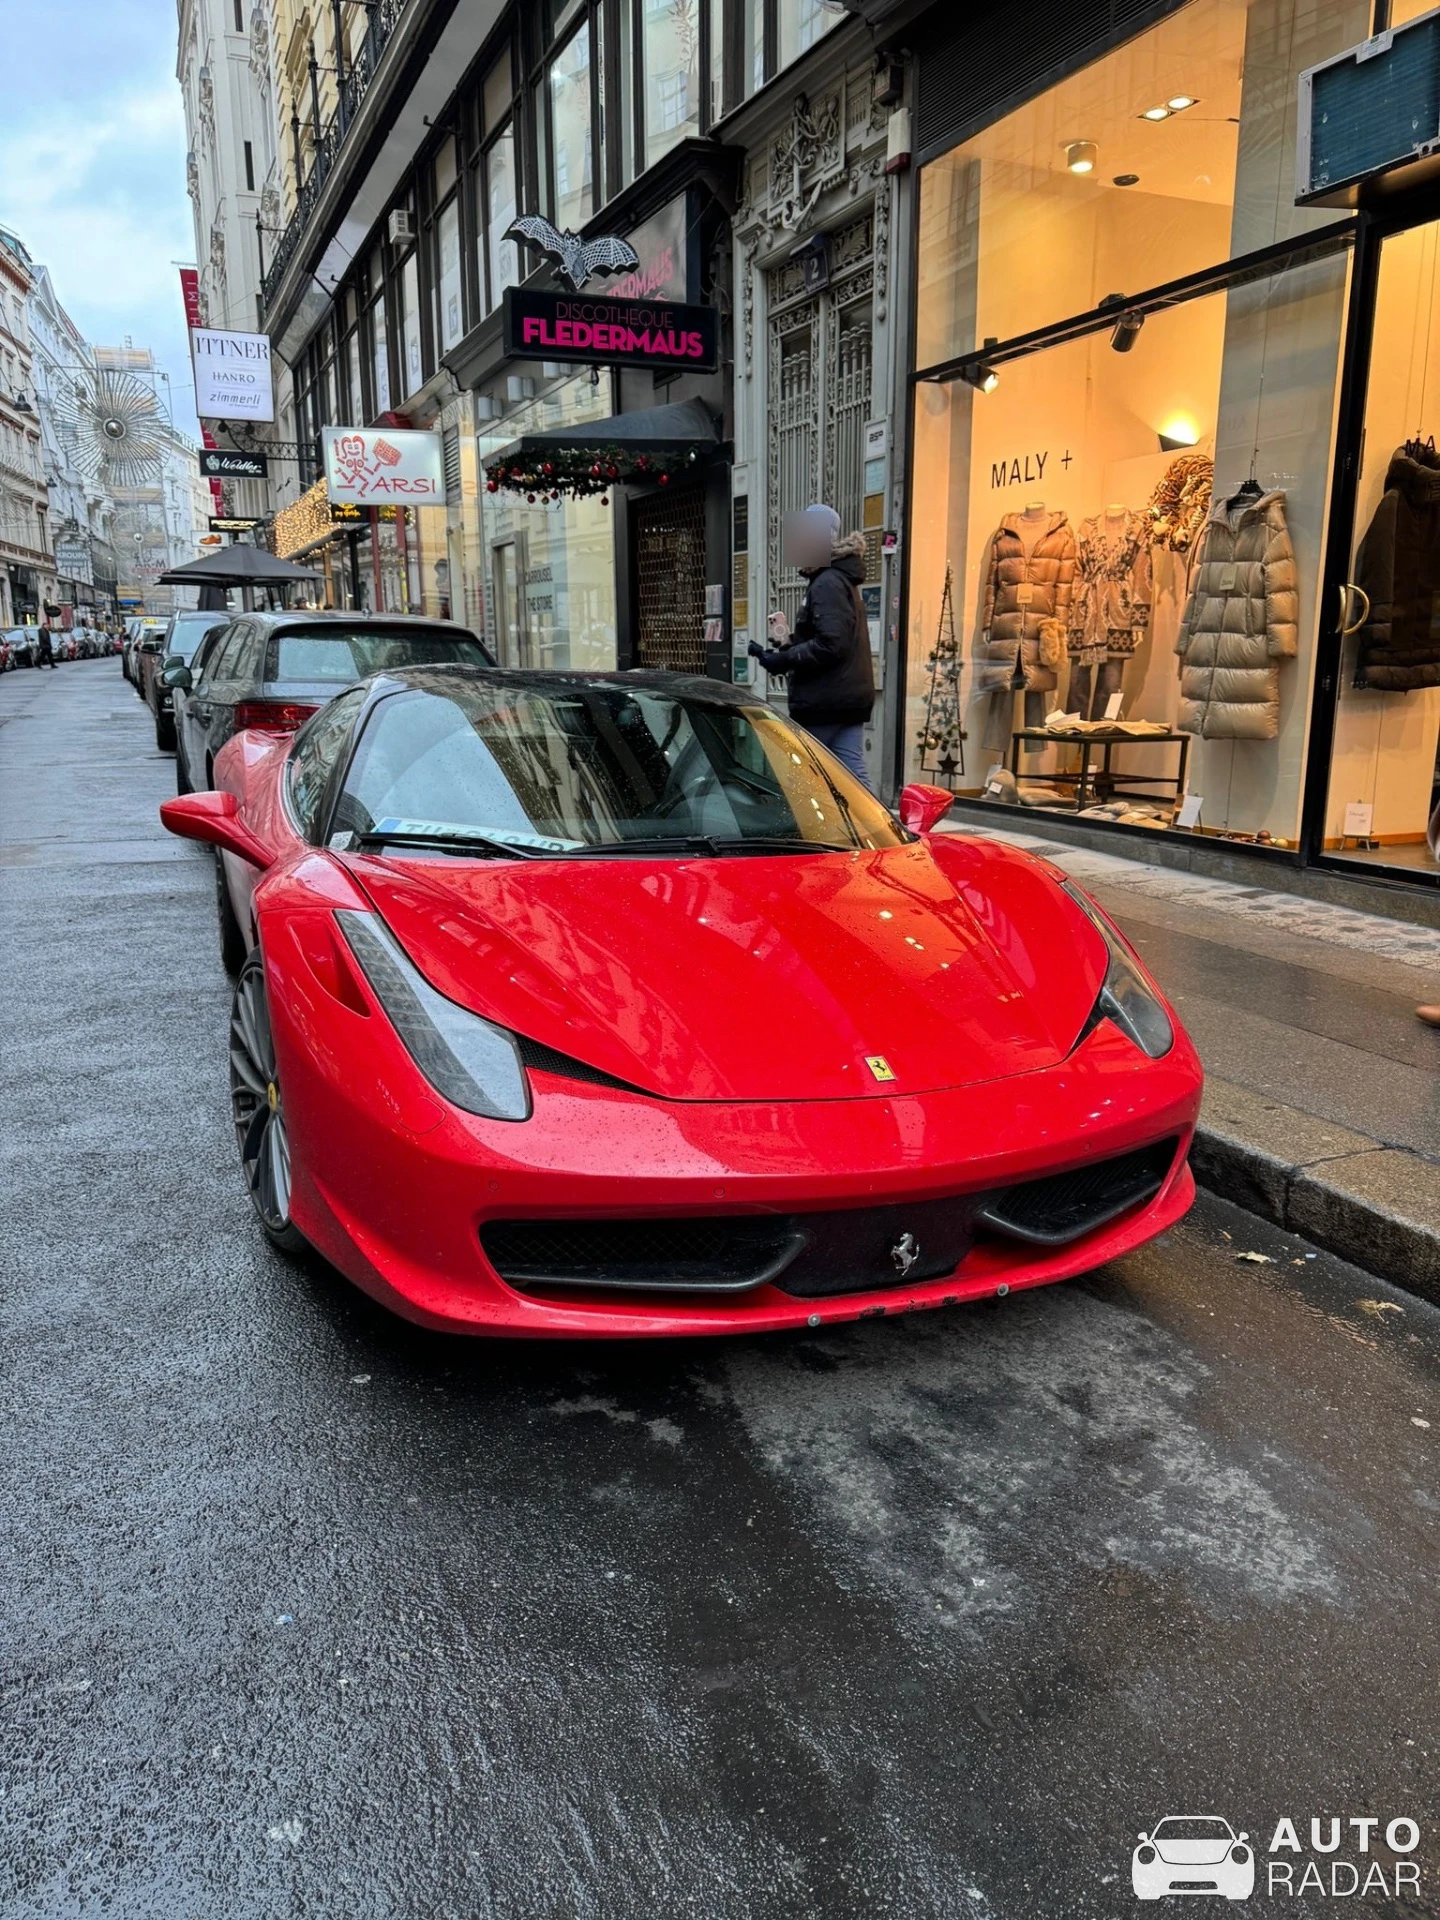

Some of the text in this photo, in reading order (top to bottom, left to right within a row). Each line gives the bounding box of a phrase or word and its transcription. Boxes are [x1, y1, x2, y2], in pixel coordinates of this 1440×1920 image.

[607, 246, 673, 300] DERMAUS
[810, 257, 819, 280] 2
[556, 302, 674, 329] DISCOTHEQUE
[196, 336, 270, 361] ITTNER
[523, 317, 704, 357] FLEDERMAUS
[212, 371, 256, 384] HANRO
[209, 391, 262, 405] zimmerli
[991, 451, 1048, 489] MALY
[370, 476, 436, 494] ARSI
[57, 551, 87, 559] KROUPA
